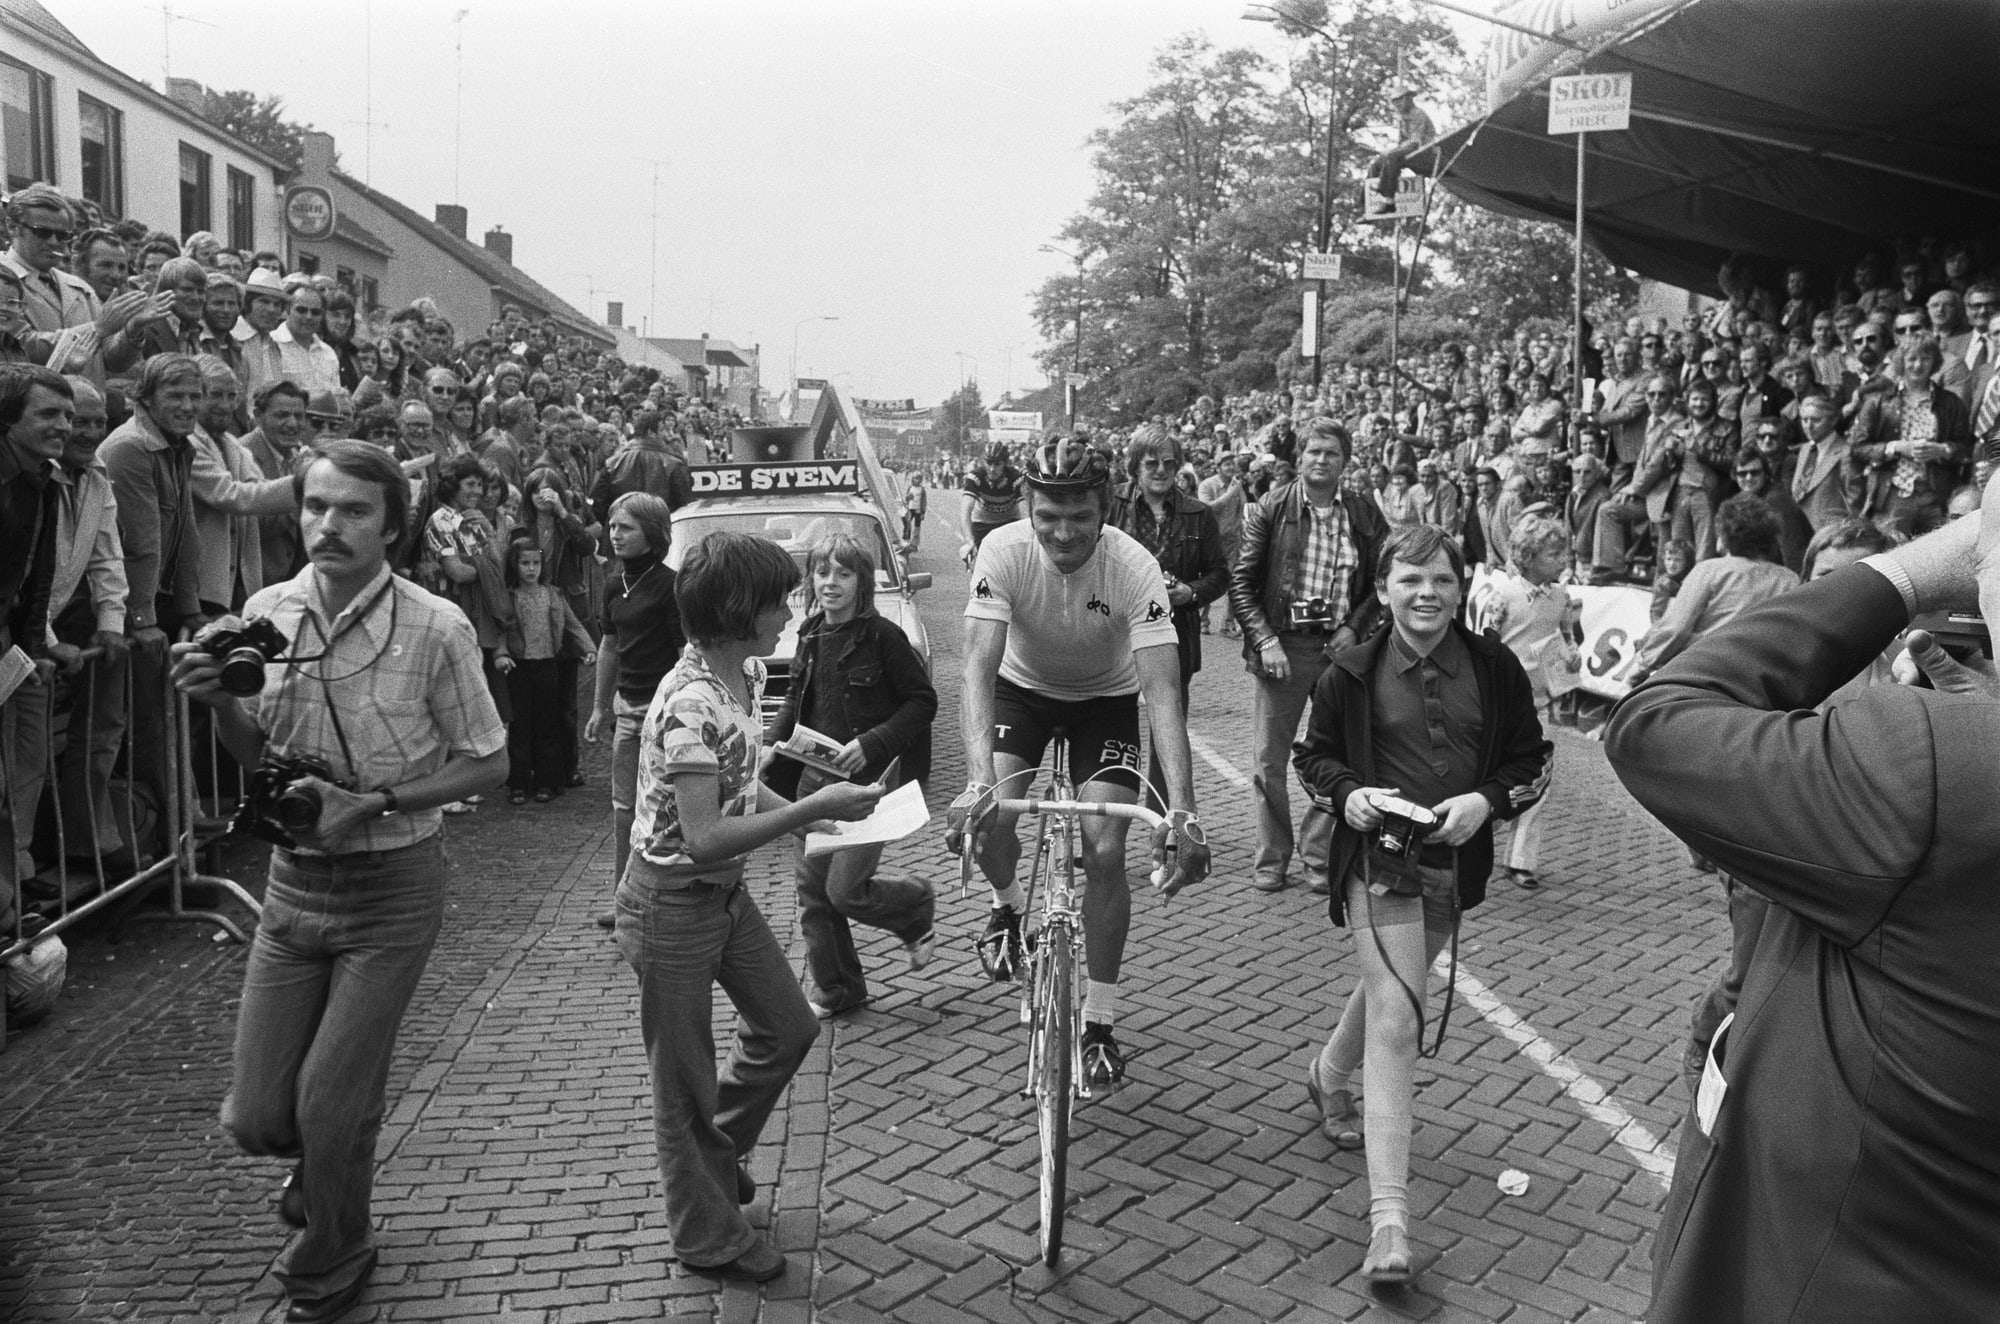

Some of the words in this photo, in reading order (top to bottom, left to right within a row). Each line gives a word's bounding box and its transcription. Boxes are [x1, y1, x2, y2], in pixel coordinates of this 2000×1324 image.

[1556, 78, 1627, 101] SKOL
[691, 469, 743, 492] DE
[750, 465, 856, 490] STEM
[995, 724, 1012, 738] T
